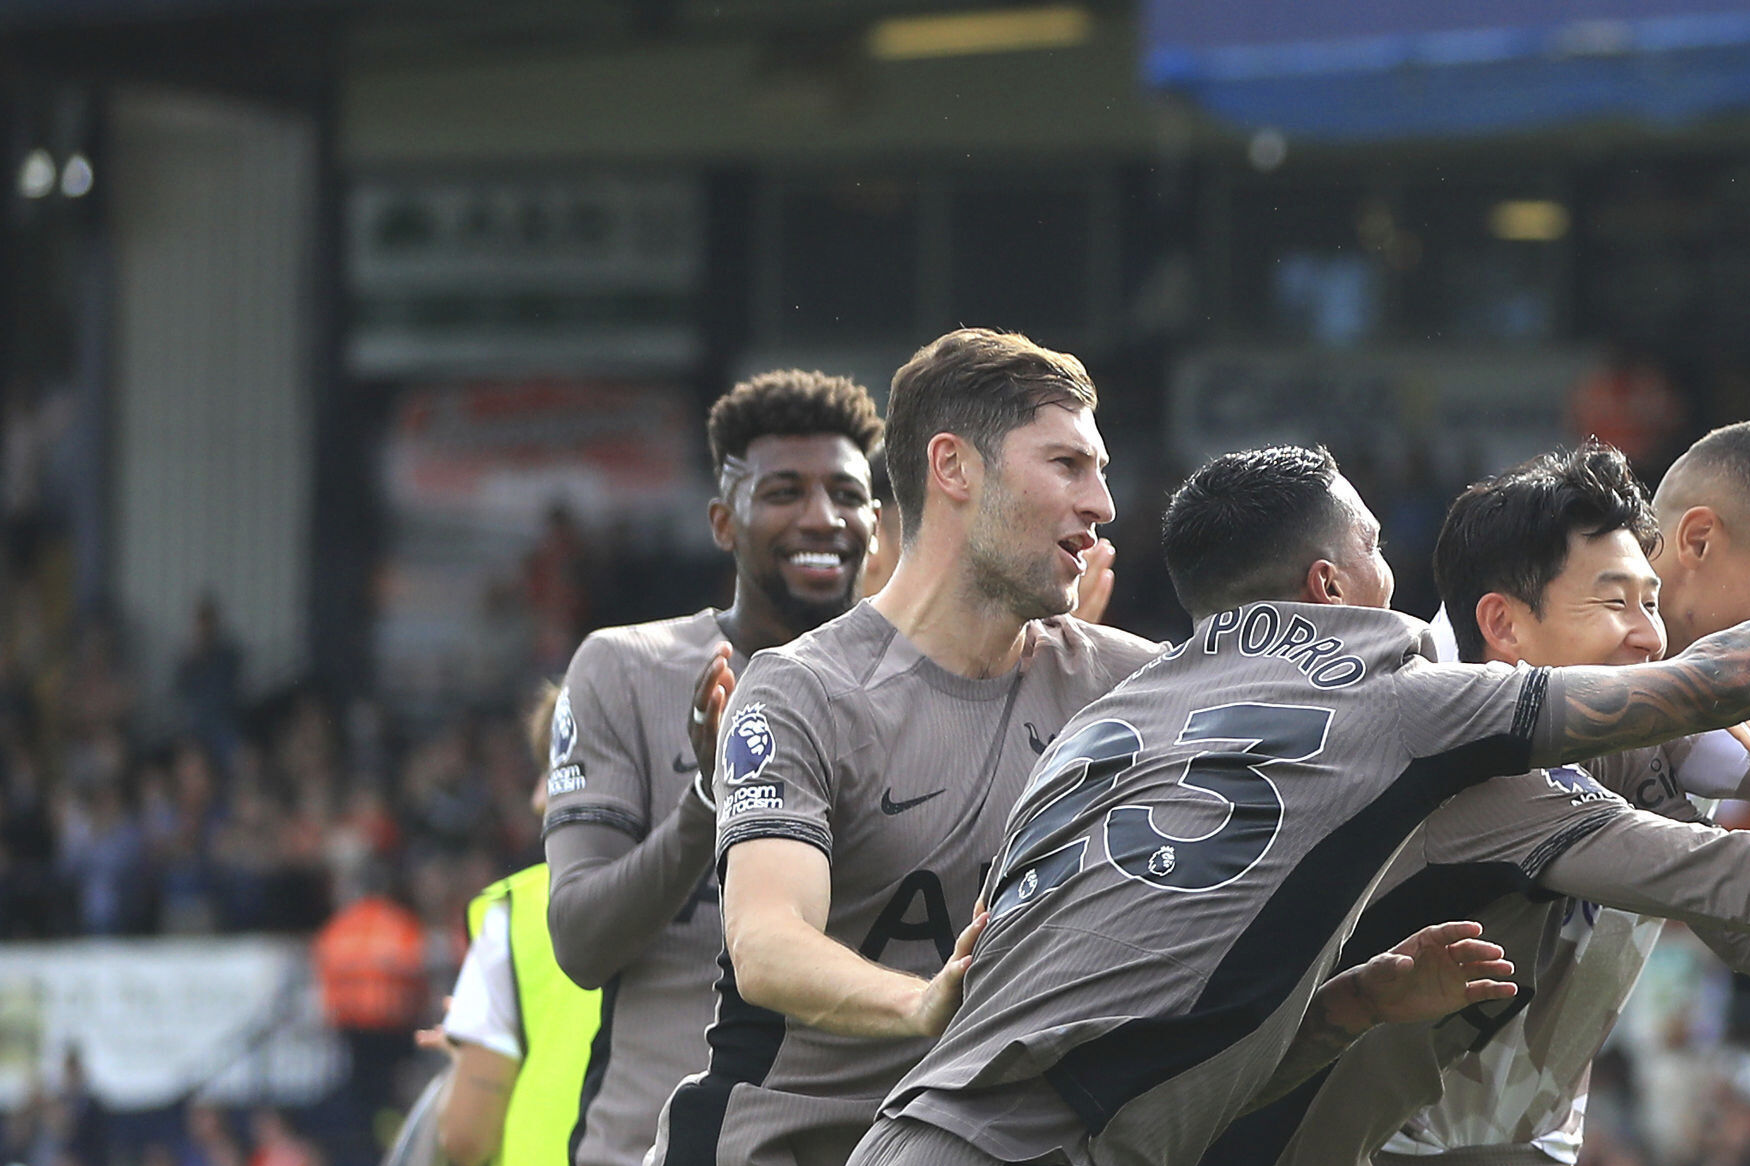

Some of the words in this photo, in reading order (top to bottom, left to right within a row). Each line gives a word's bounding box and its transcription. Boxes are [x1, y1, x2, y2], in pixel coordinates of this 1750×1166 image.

[1203, 602, 1367, 691] PORRO
[732, 797, 783, 815] racism
[734, 785, 776, 803] room
[986, 700, 1337, 914] 23
